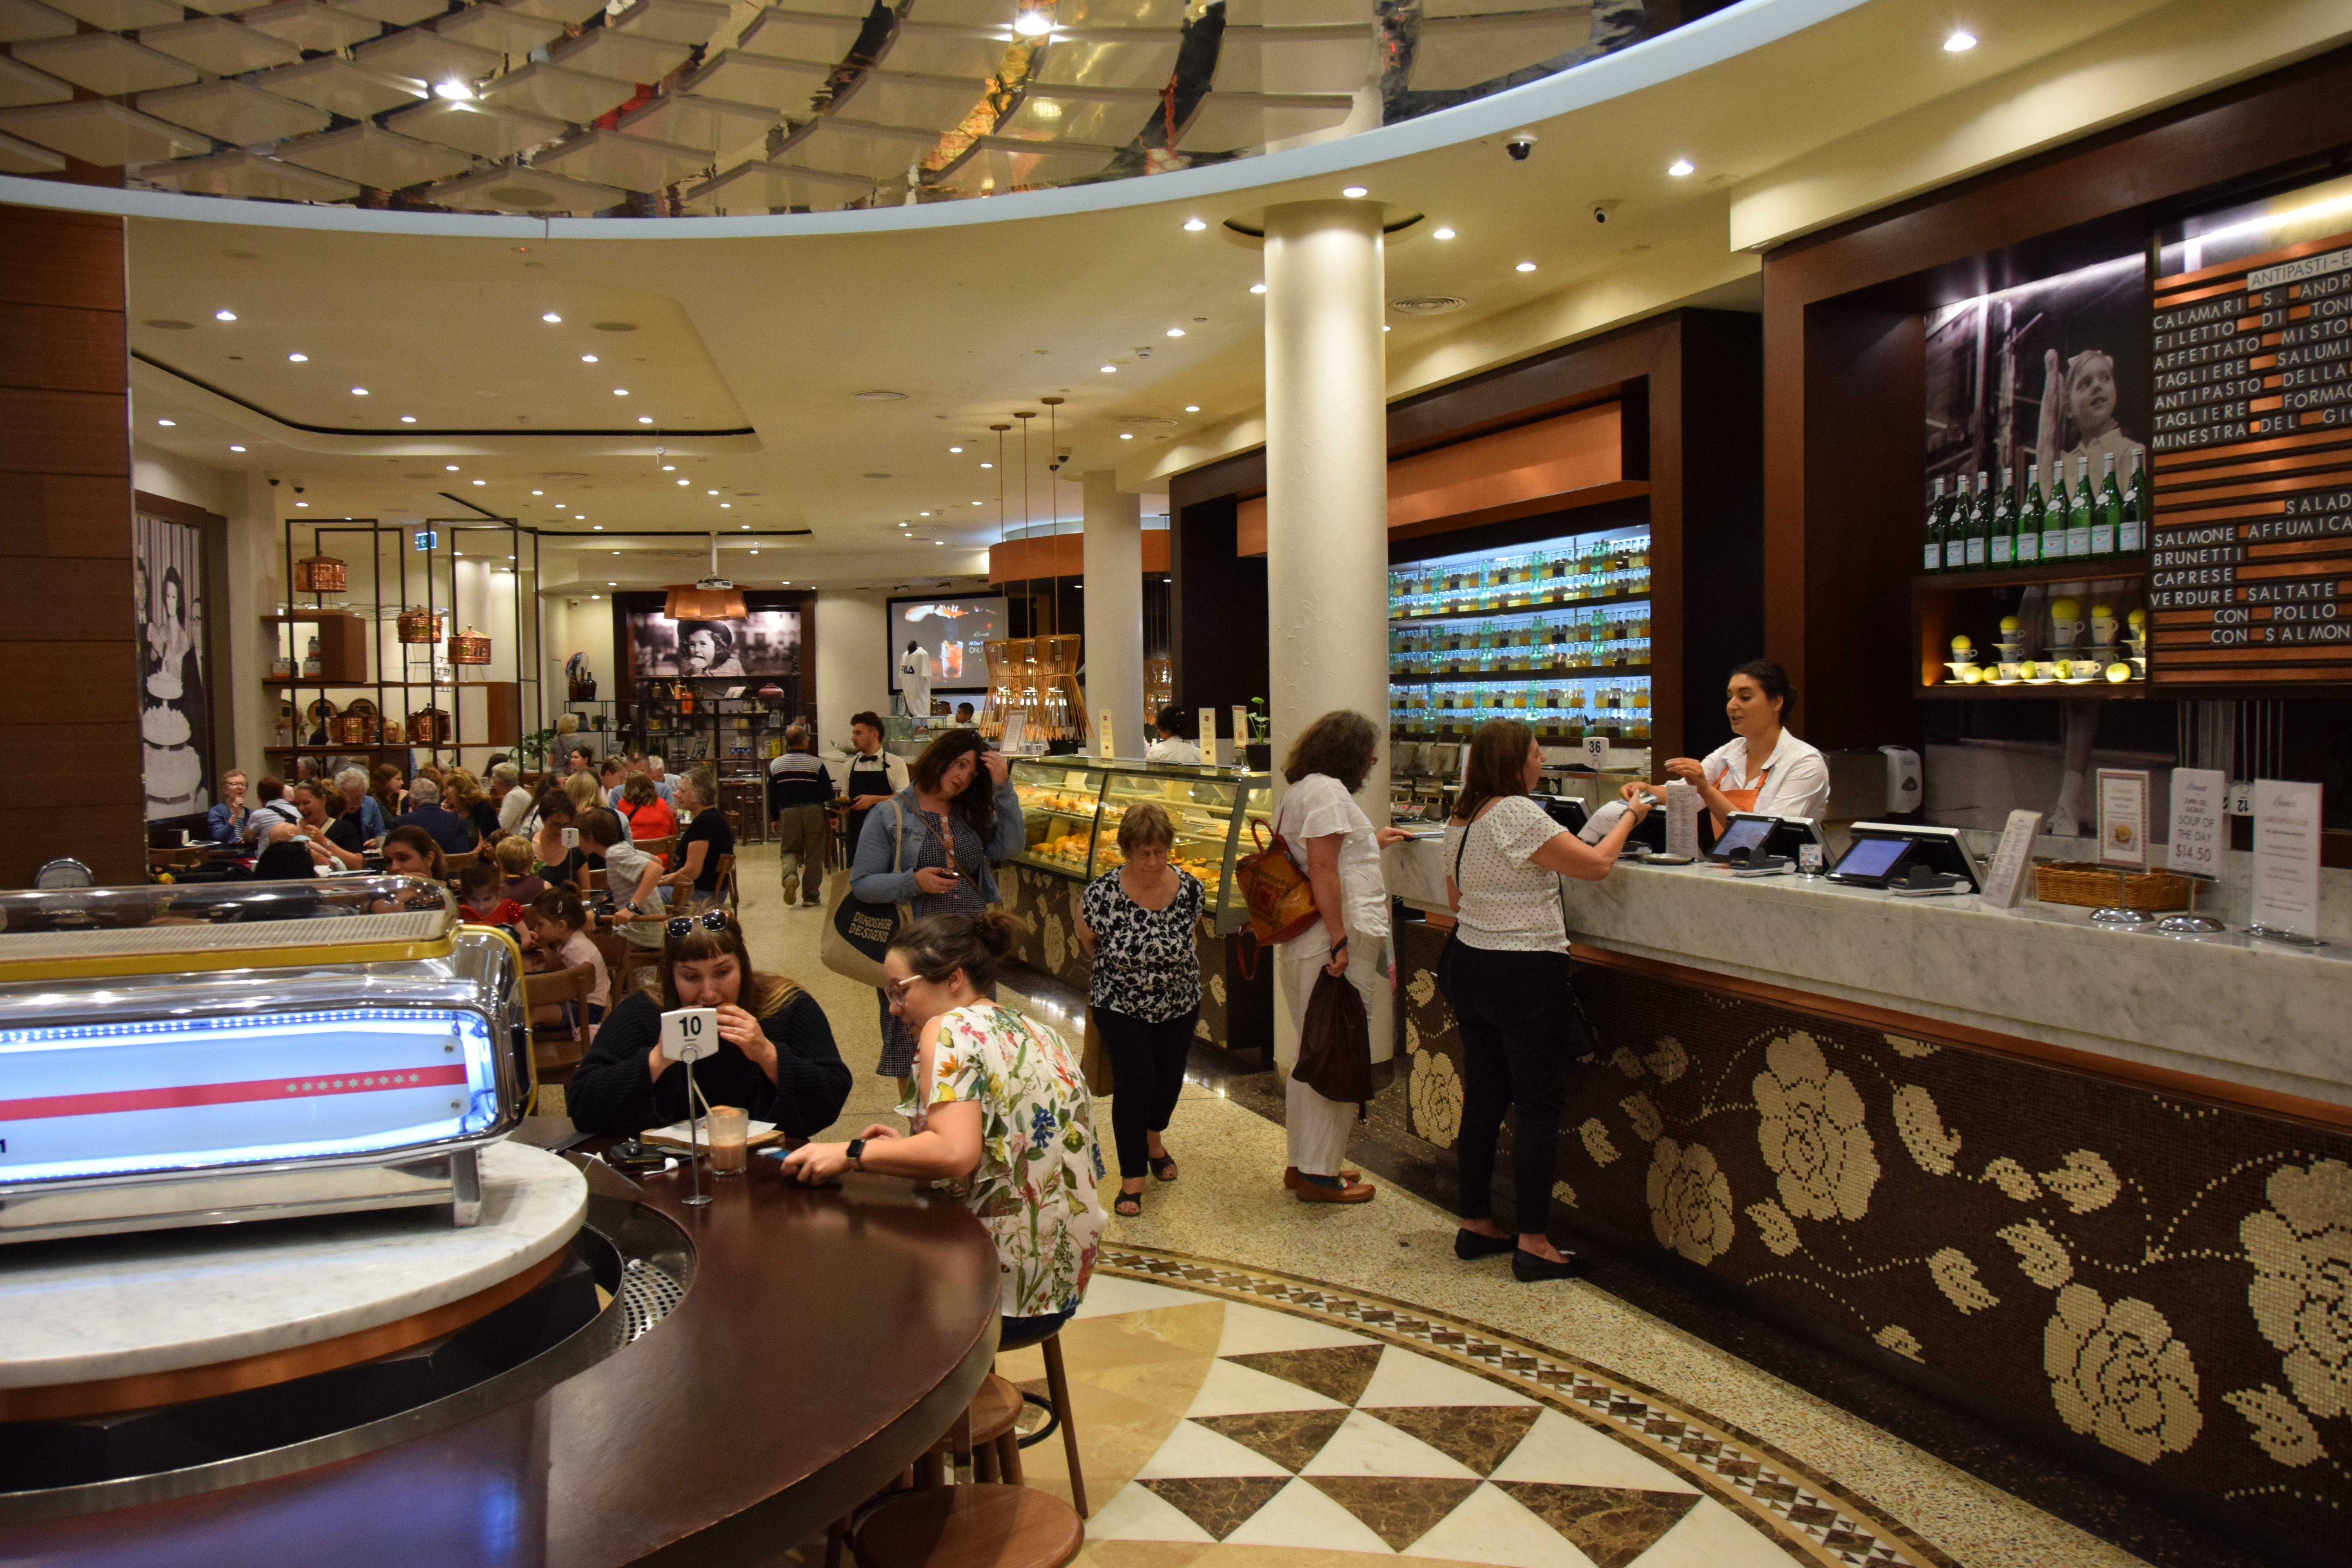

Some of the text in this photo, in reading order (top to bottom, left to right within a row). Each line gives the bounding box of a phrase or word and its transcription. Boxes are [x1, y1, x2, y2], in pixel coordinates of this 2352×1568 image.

[2153, 298, 2241, 329] CALAMARI
[2301, 274, 2351, 298] ANDR
[2156, 296, 2352, 349] FILETTO DI TON
[2154, 319, 2348, 370] AFFETTATO MISTO
[2156, 339, 2349, 389] TAGLIERE SALUMI
[2155, 363, 2347, 409] ANTIPASTO DELLA
[2155, 402, 2245, 429] TAGLIERE
[2152, 408, 2352, 448] MINESTRA DEL GI
[2286, 494, 2351, 514] SALAD
[2155, 515, 2352, 547] SALMONE AFFUMICA
[2154, 548, 2241, 566] BRUNETTI
[2153, 568, 2232, 587] CAPRESE
[2150, 583, 2334, 606] VERDURE SALTATE
[2213, 603, 2336, 623] CON POLLO
[2210, 624, 2350, 644] CON SALMON
[901, 665, 915, 674] FILA
[1590, 741, 1601, 753] 36
[2238, 799, 2249, 812] 12
[2179, 815, 2214, 828] SOUP OF
[2178, 829, 2212, 842] THE DAY
[2176, 844, 2212, 862] $14.50
[853, 911, 892, 930] DINOSAUR
[848, 923, 889, 943] DESIGNS
[679, 1016, 701, 1036] 10
